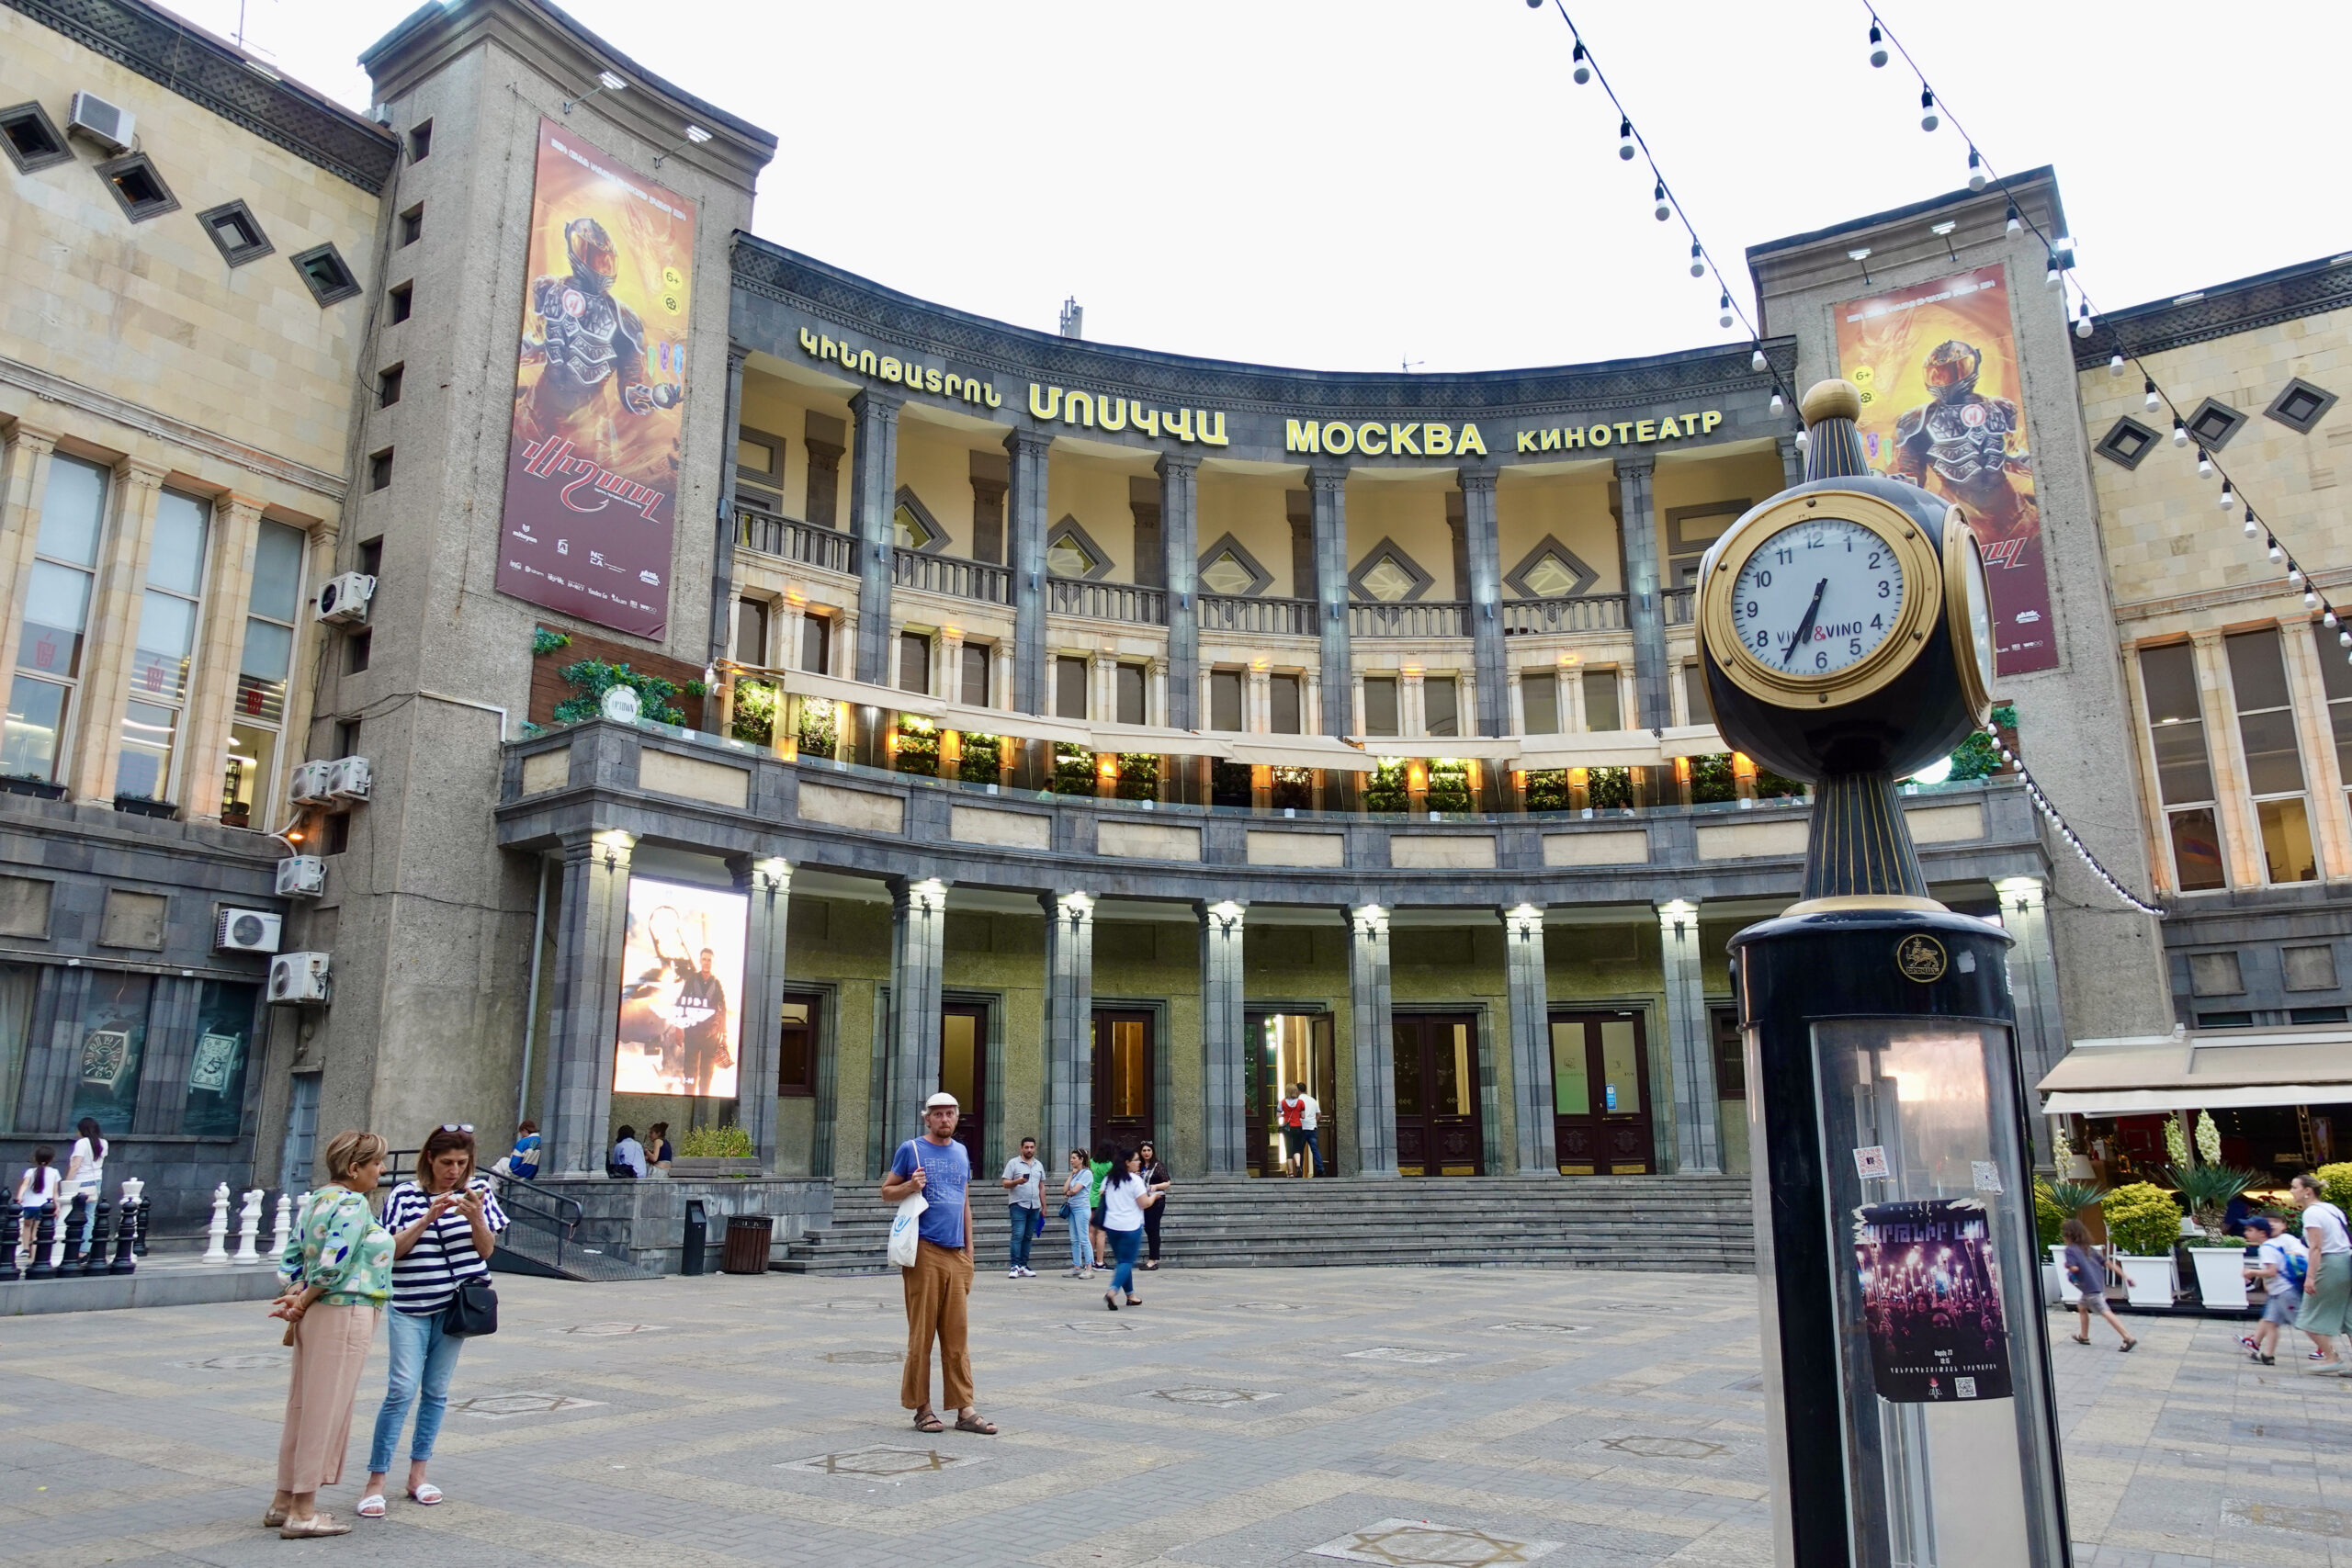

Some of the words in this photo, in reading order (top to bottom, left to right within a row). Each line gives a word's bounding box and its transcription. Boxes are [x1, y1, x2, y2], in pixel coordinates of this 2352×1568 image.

[666, 272, 679, 284] 6+
[798, 327, 1001, 409] ԿԻՆՈԹԱՏՐՈՆ
[1856, 372, 1871, 380] 6+
[1029, 383, 1228, 446] ՄՈՍԿՎԱ
[1286, 419, 1487, 456] МОСКВА
[1517, 410, 1723, 453] КИНОТЕАТР
[1804, 532, 1825, 548] 12
[1843, 536, 1852, 552] 1
[1776, 547, 1792, 565] 11
[1869, 552, 1881, 570] 2
[1753, 570, 1771, 588] 10
[1878, 581, 1890, 598] 3
[1747, 602, 1758, 617] 9
[1871, 614, 1883, 630] 4
[1757, 630, 1768, 647] 8
[1849, 637, 1861, 655] 5
[1815, 651, 1827, 669] 6
